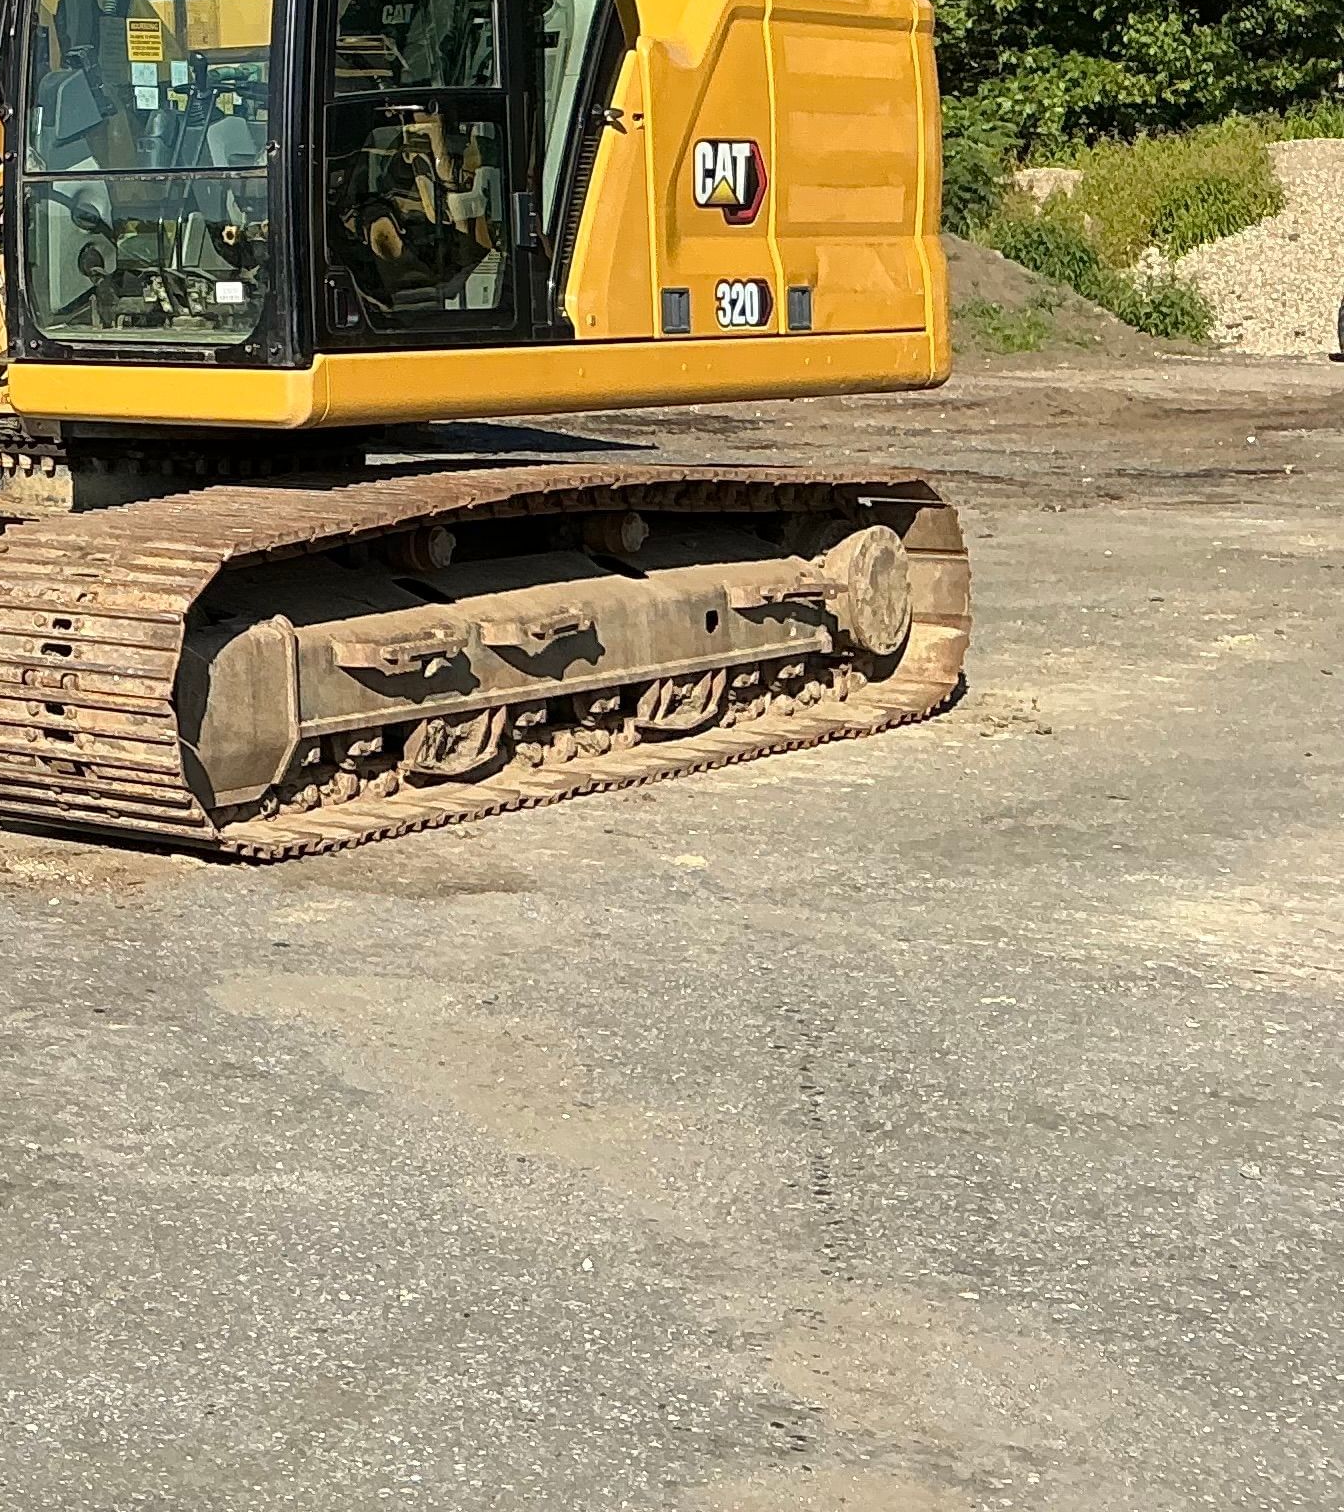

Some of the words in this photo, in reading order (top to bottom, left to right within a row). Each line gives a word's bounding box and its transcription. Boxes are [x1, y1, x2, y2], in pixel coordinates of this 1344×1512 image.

[382, 4, 414, 25] CAT
[694, 140, 752, 206] CAT
[716, 282, 760, 326] 320
